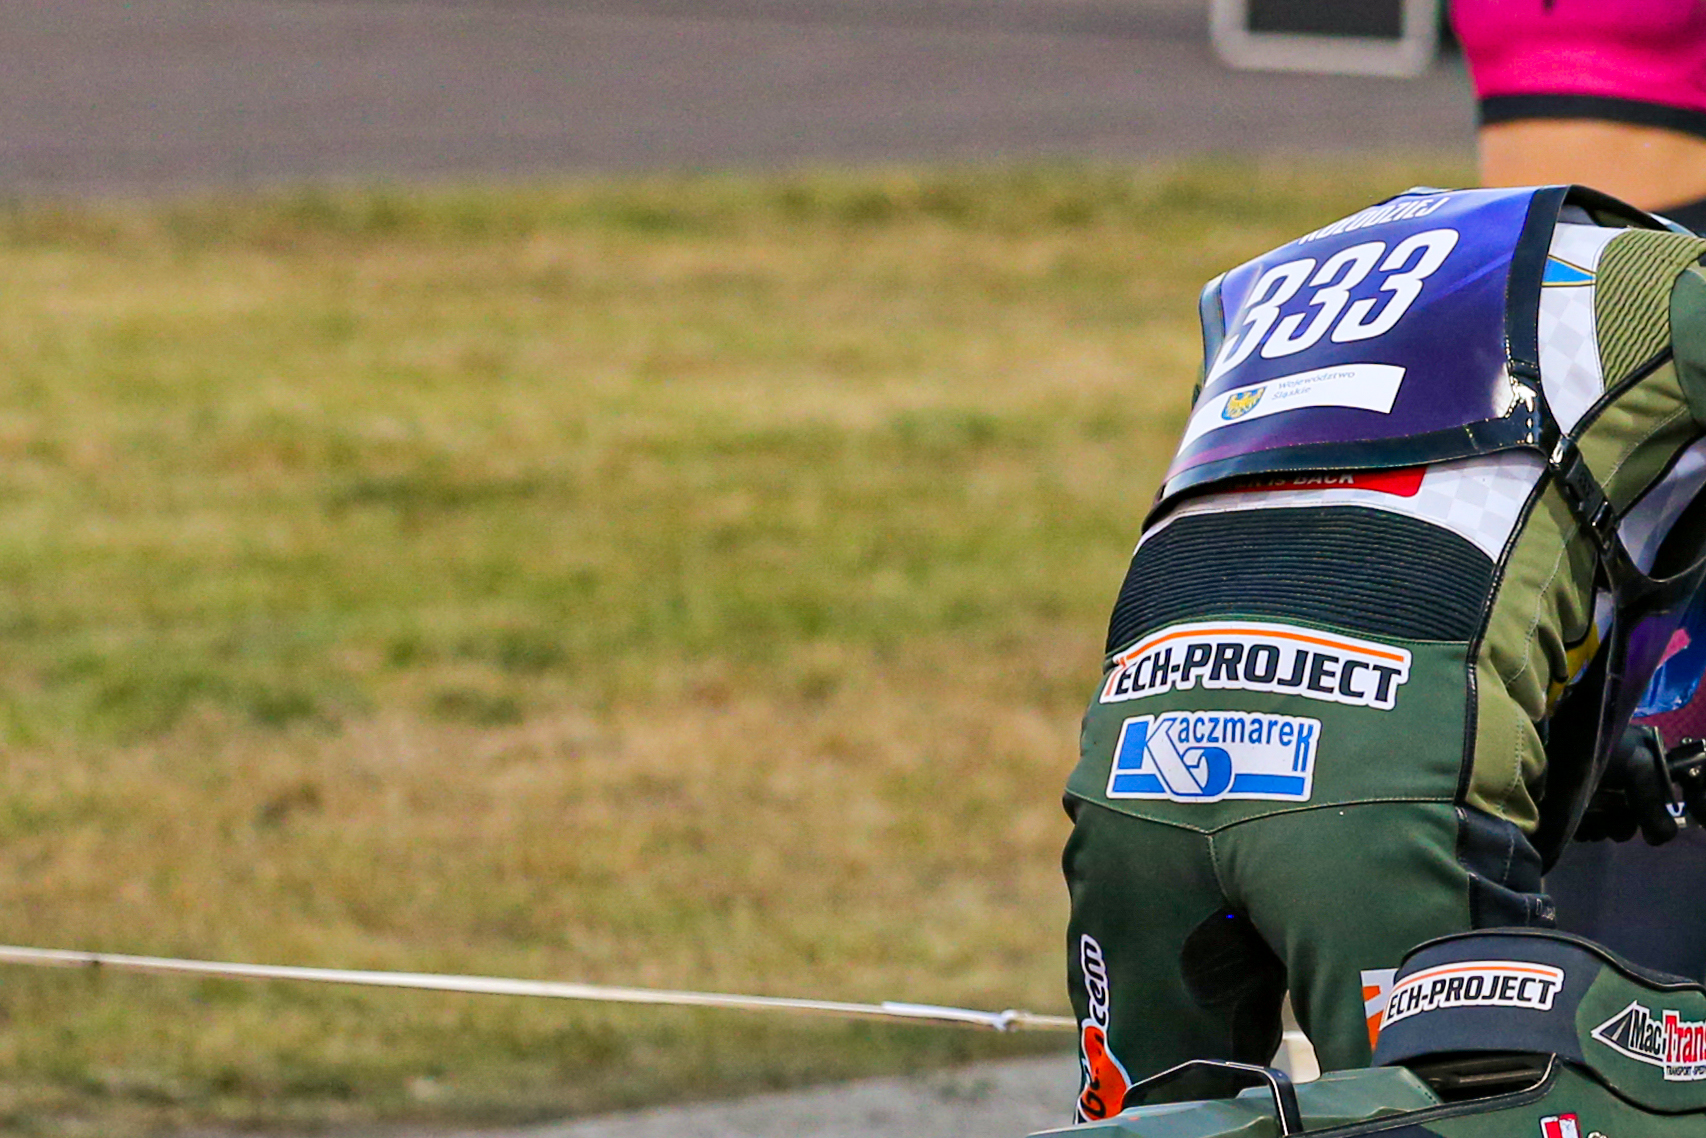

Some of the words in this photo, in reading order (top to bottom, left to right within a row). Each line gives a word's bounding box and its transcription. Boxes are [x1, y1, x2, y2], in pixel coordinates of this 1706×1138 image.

[1204, 228, 1460, 388] 333
[1272, 385, 1312, 401] Śląskie
[1278, 370, 1356, 391] Województwo
[1103, 628, 1405, 703] TECH-PROJECT
[1382, 965, 1558, 1020] ECH-PROJECT
